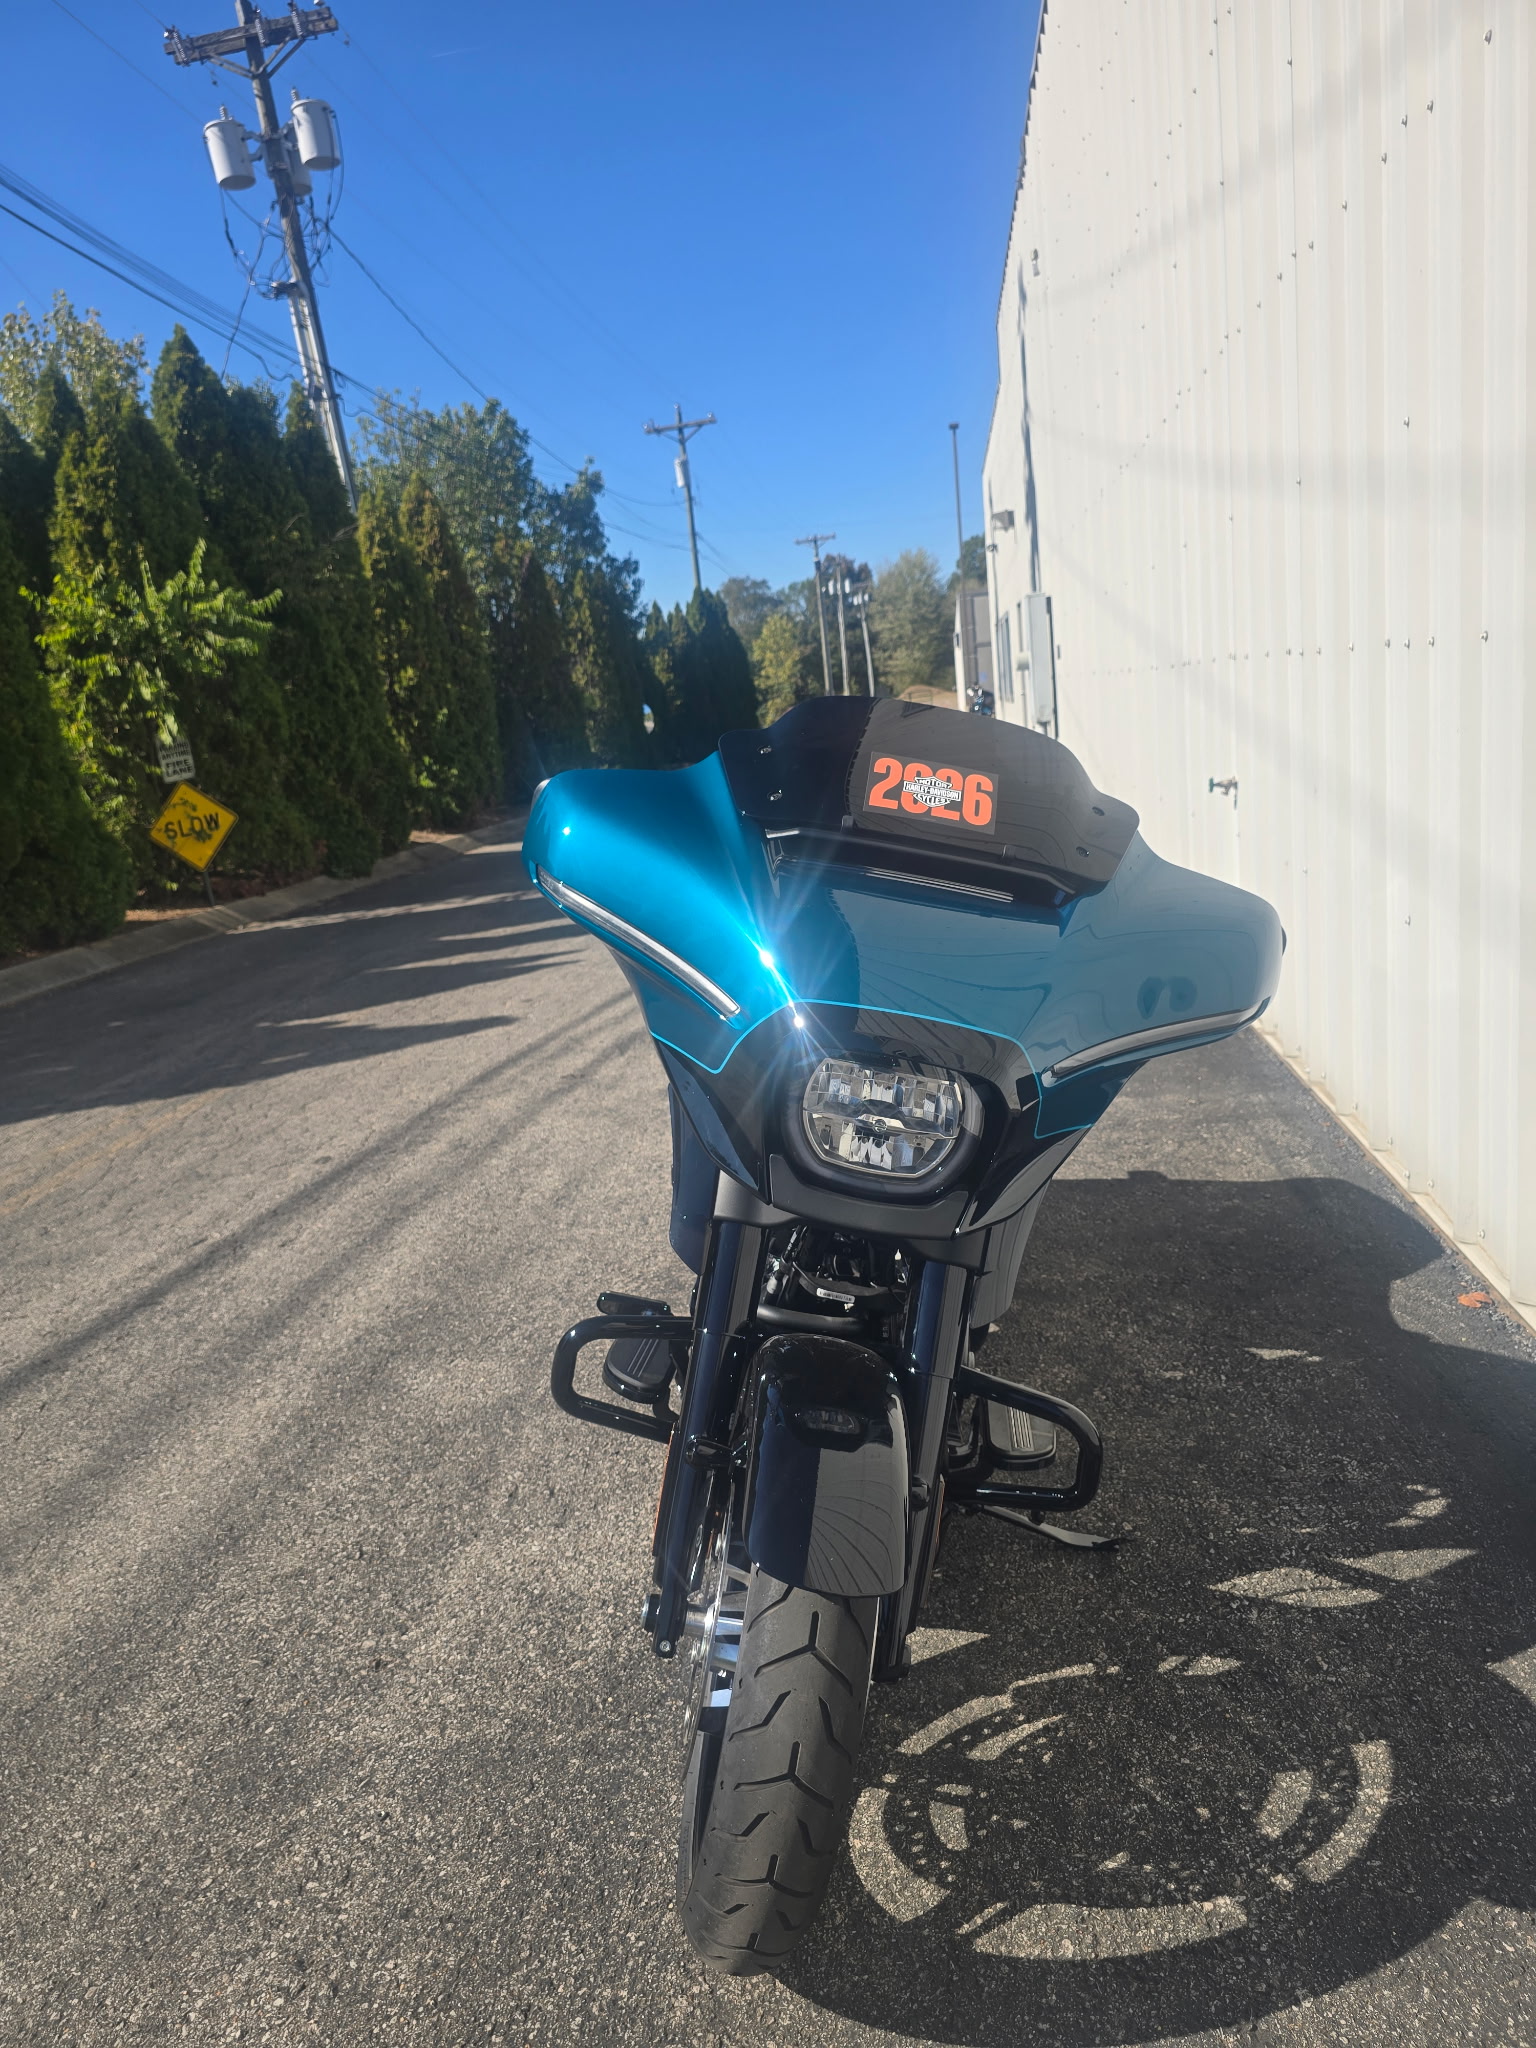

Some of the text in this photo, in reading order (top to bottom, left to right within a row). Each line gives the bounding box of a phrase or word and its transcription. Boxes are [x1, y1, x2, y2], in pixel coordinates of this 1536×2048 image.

[162, 750, 190, 760] ANYTIME
[166, 759, 191, 769] FIRE
[166, 766, 192, 777] LANE
[919, 778, 947, 789] MOTOR
[869, 758, 993, 825] 2026
[905, 783, 959, 799] HARLEY-DAVIDSON
[917, 795, 946, 806] CYCLES
[164, 812, 220, 839] SLOW
